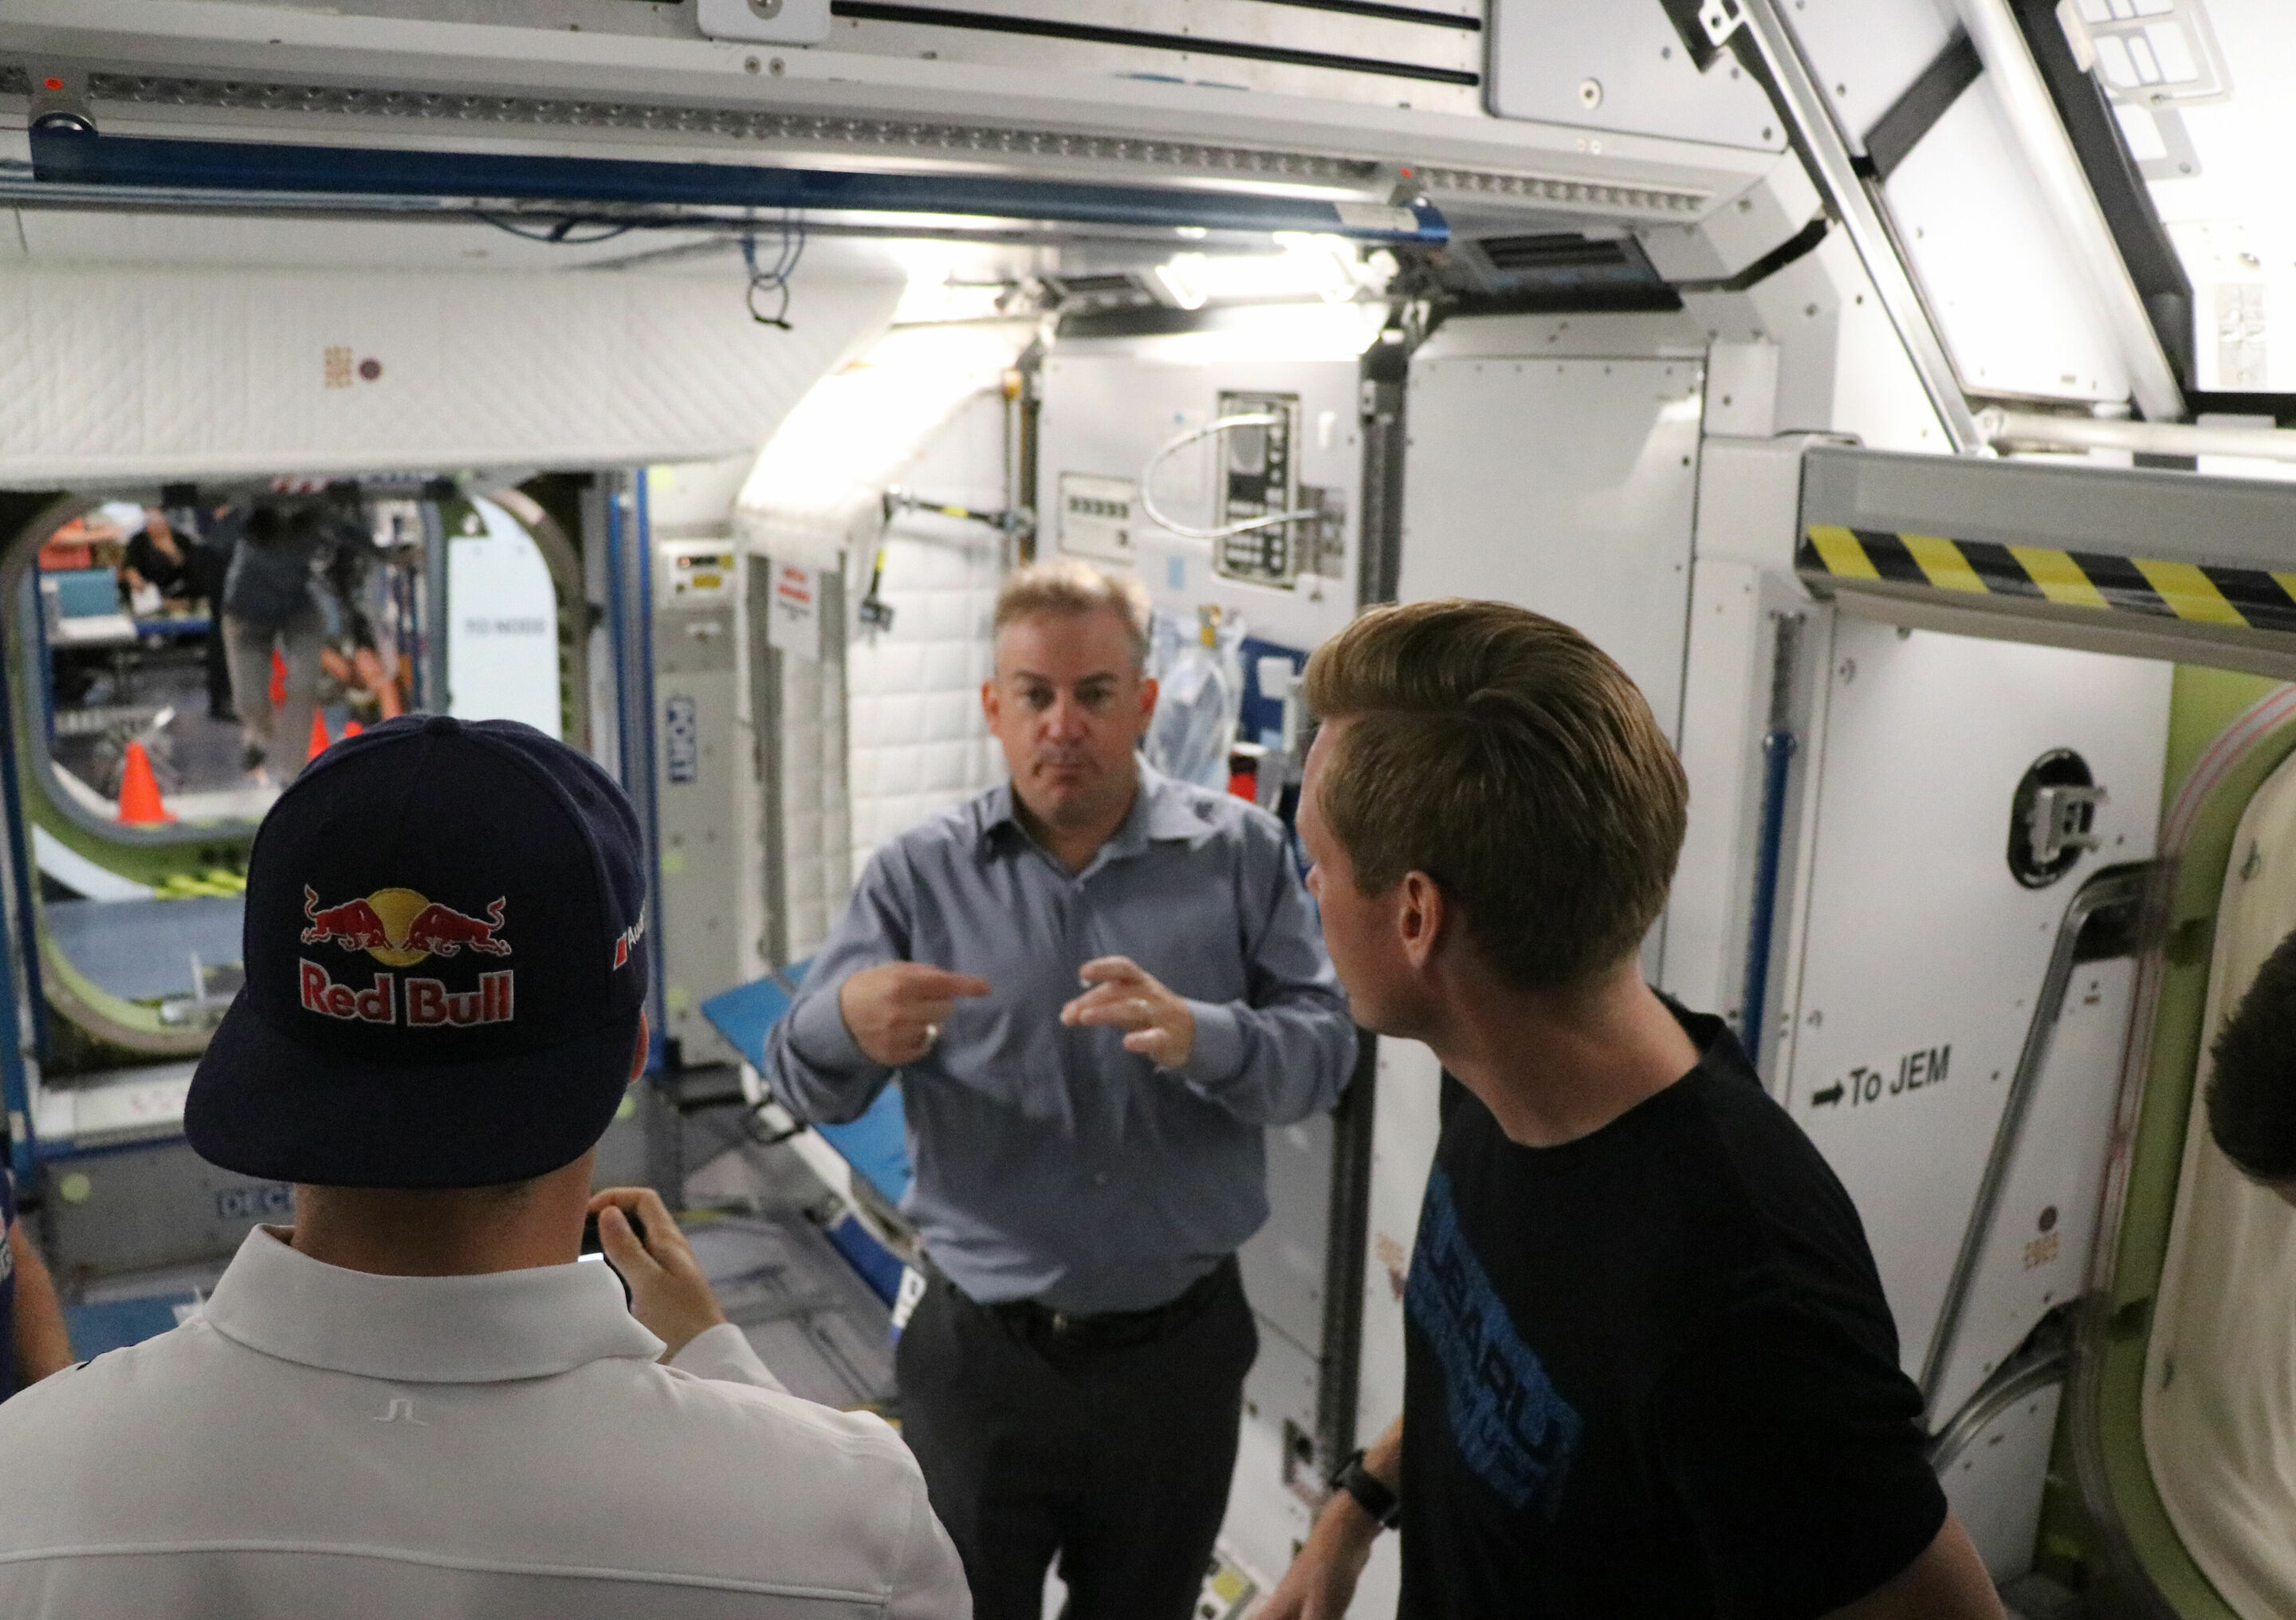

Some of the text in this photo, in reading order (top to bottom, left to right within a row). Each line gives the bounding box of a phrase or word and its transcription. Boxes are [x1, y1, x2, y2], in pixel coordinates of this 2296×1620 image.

[300, 957, 514, 1026] Red Bull
[1848, 1044, 1951, 1107] To JEM
